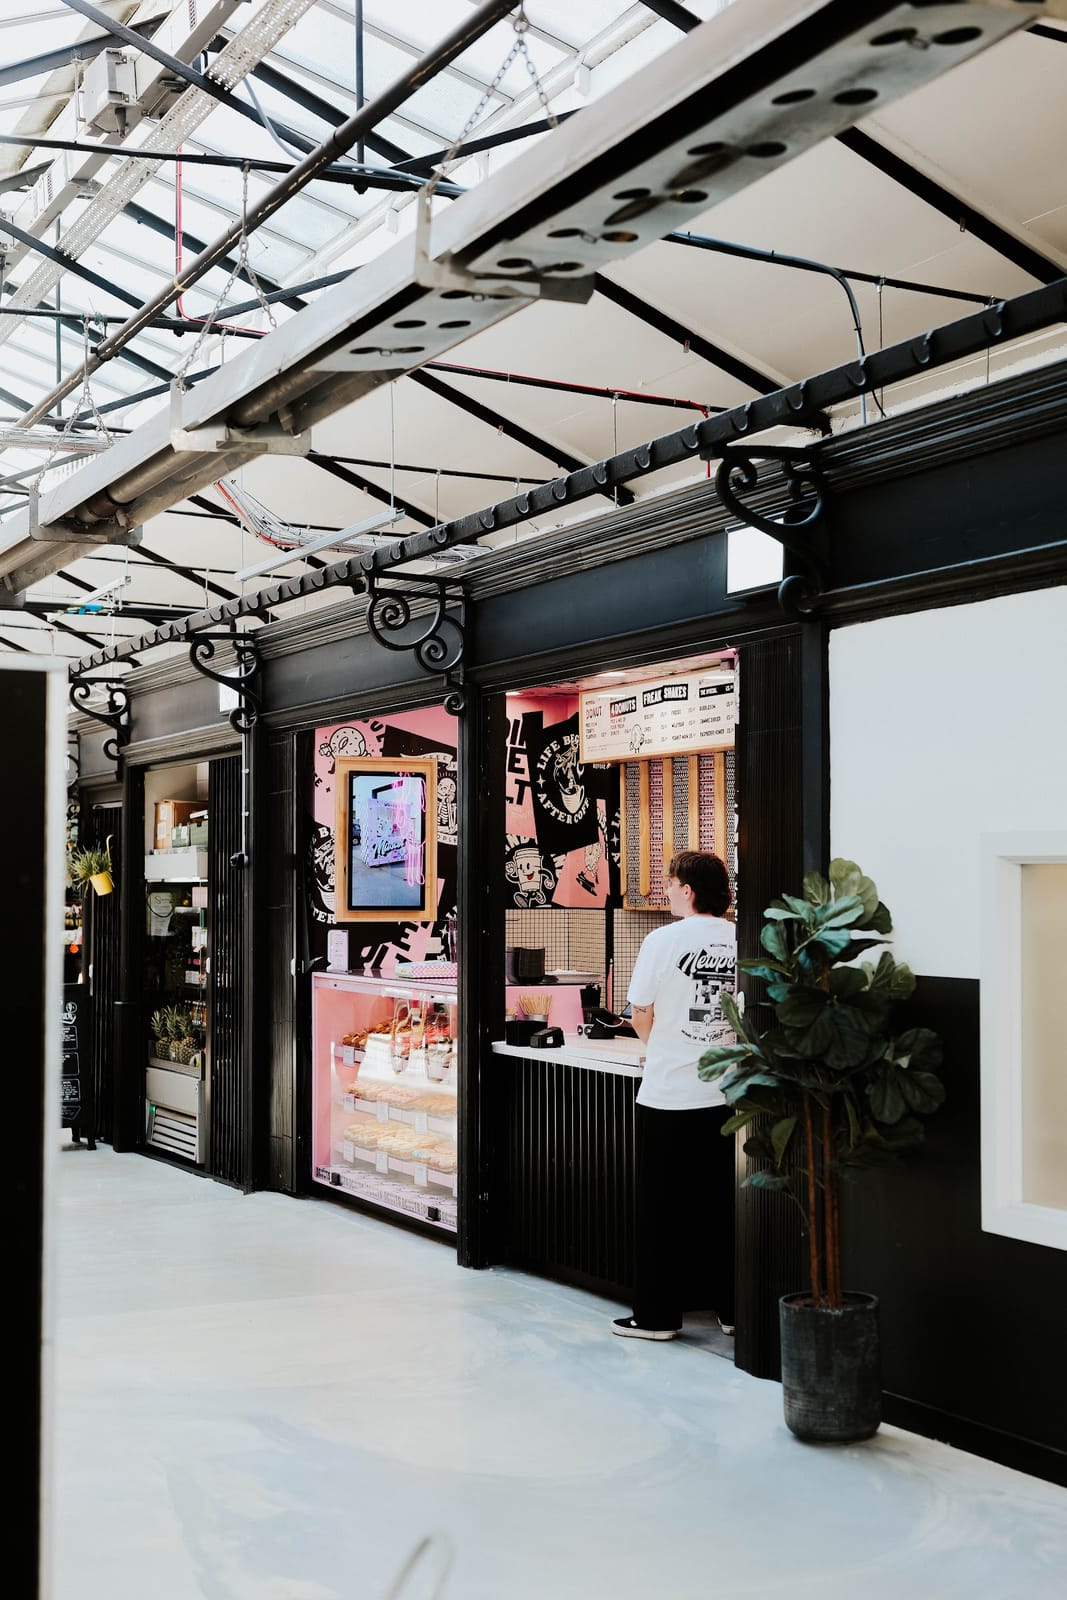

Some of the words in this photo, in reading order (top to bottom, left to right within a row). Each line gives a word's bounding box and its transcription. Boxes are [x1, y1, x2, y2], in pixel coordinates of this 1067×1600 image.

[615, 699, 636, 714] DONUTS
[643, 689, 662, 706] FREAK
[663, 686, 687, 699] SHAKES
[536, 740, 560, 770] LIFE
[537, 792, 573, 825] AFTER
